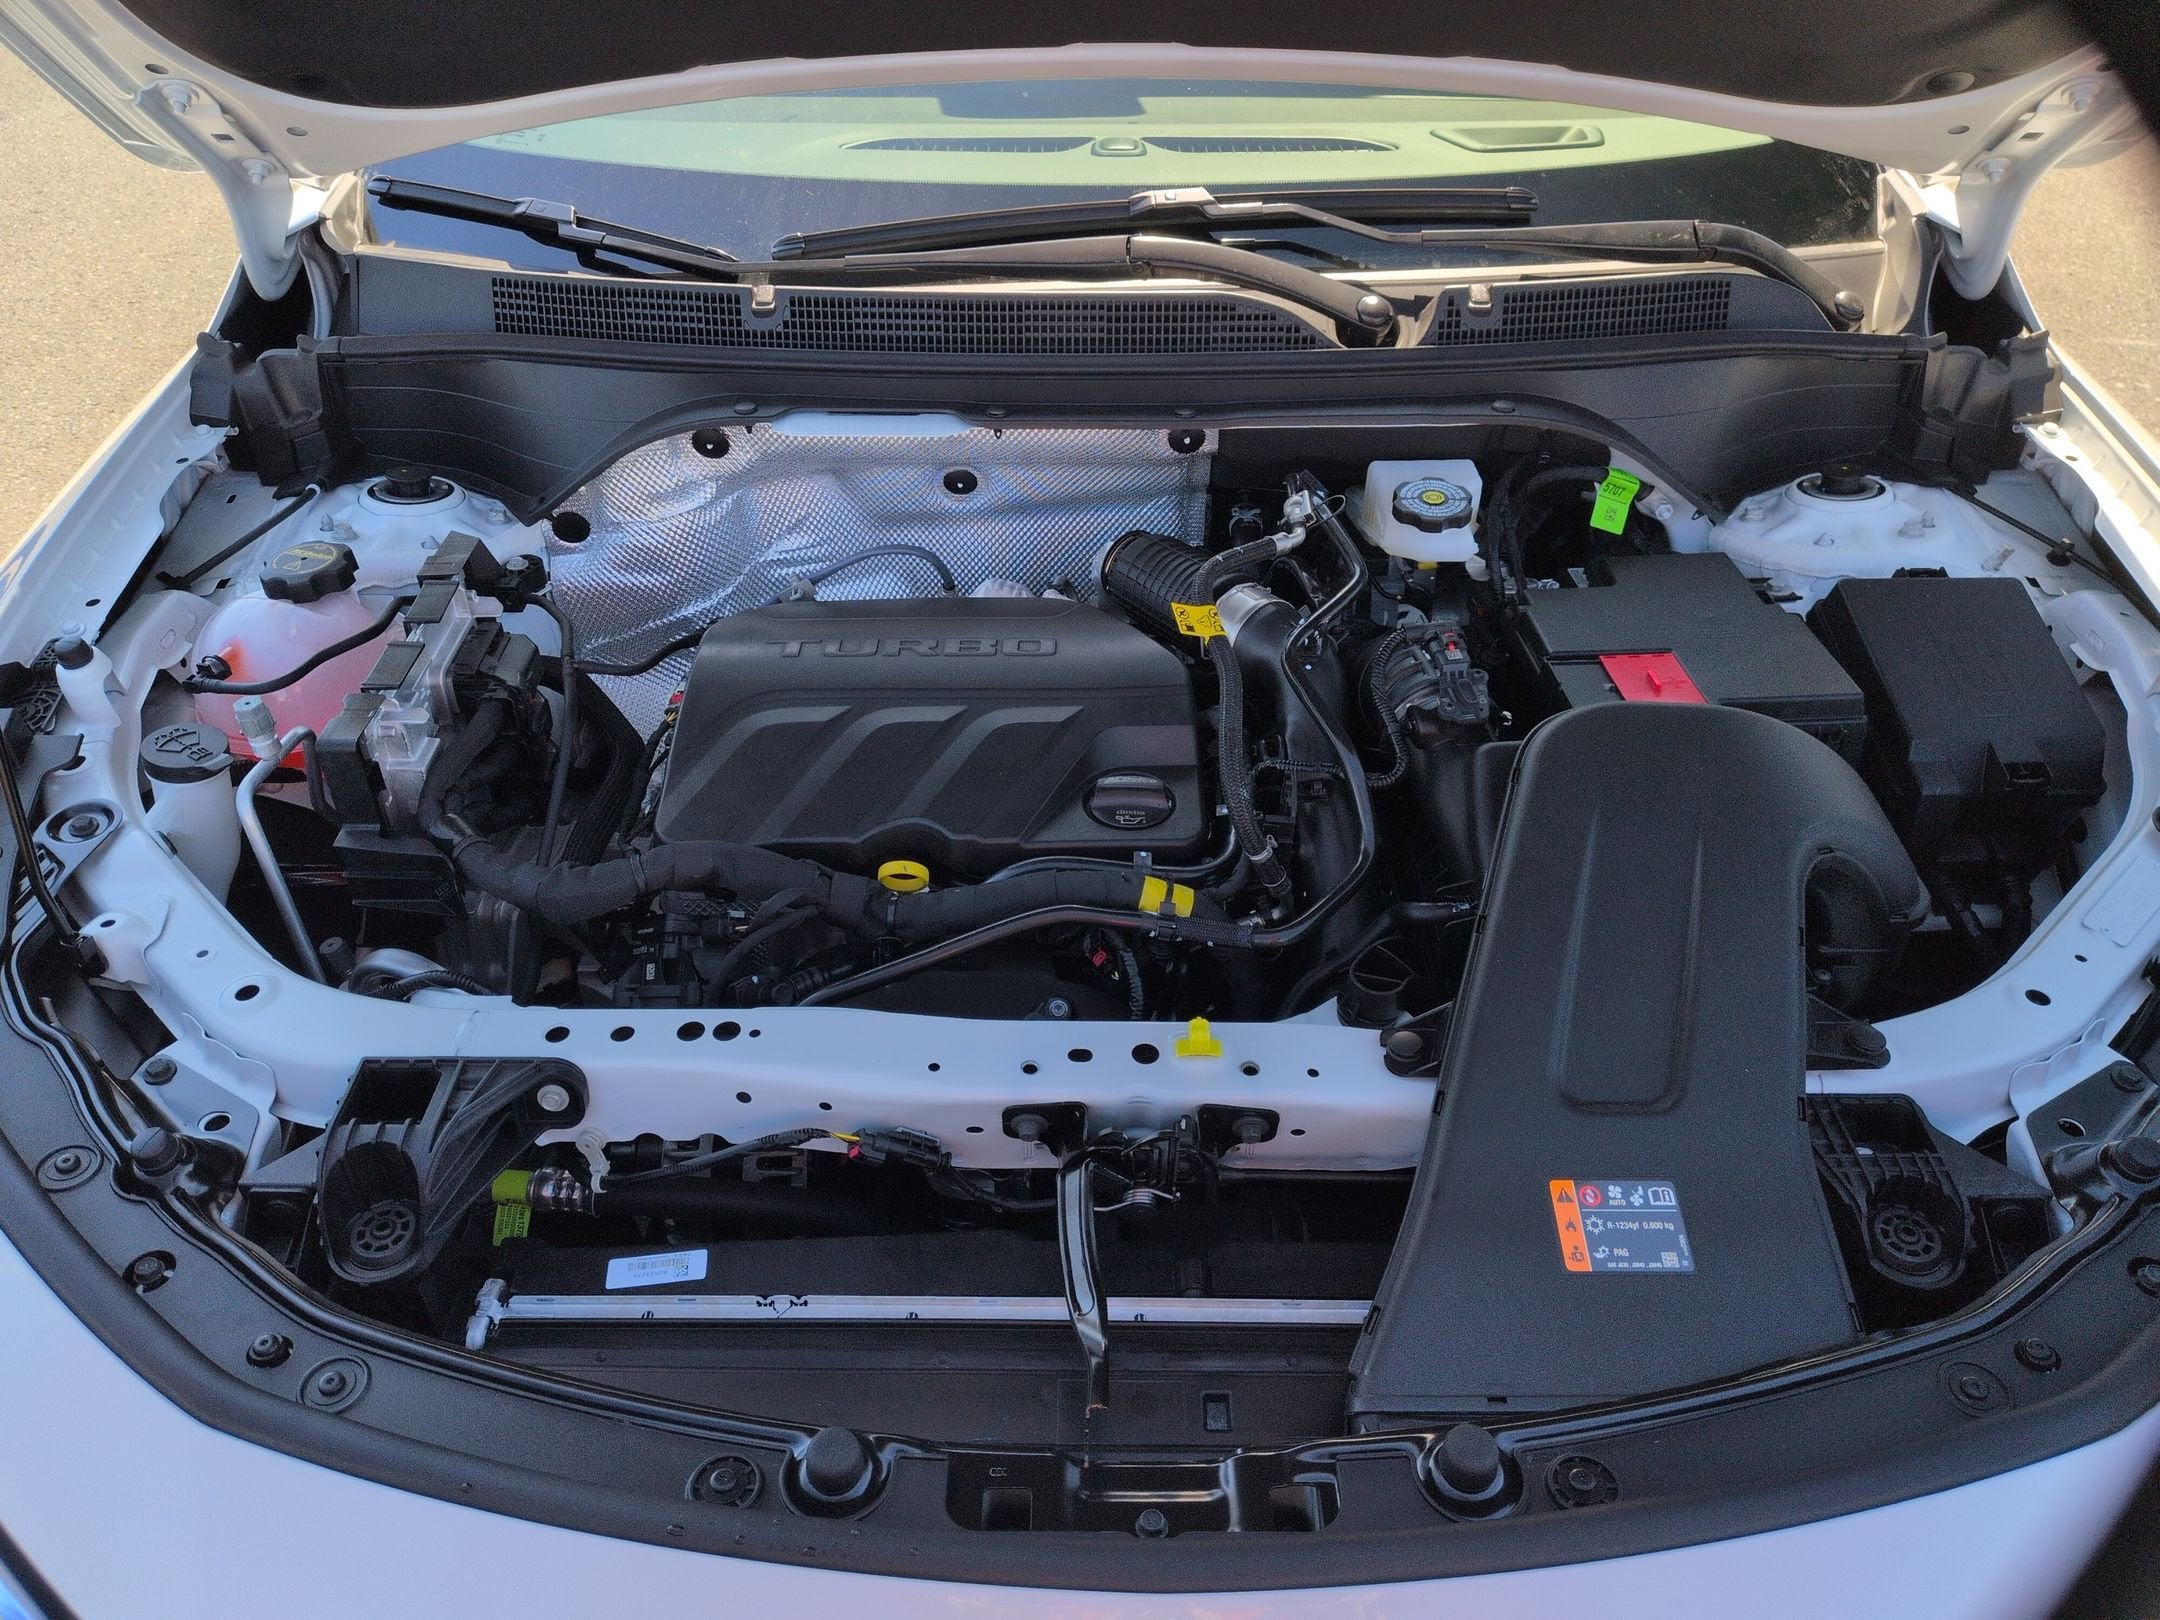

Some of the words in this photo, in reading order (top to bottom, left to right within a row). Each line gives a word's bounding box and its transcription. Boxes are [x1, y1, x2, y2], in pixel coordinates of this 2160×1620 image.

[1603, 482, 1626, 498] 5707
[766, 638, 1058, 658] TURBO
[1607, 1222, 1639, 1230] R-1234yf
[1643, 1222, 1663, 1230] 0.600
[1665, 1222, 1674, 1231] kg
[1613, 1248, 1629, 1256] PAG
